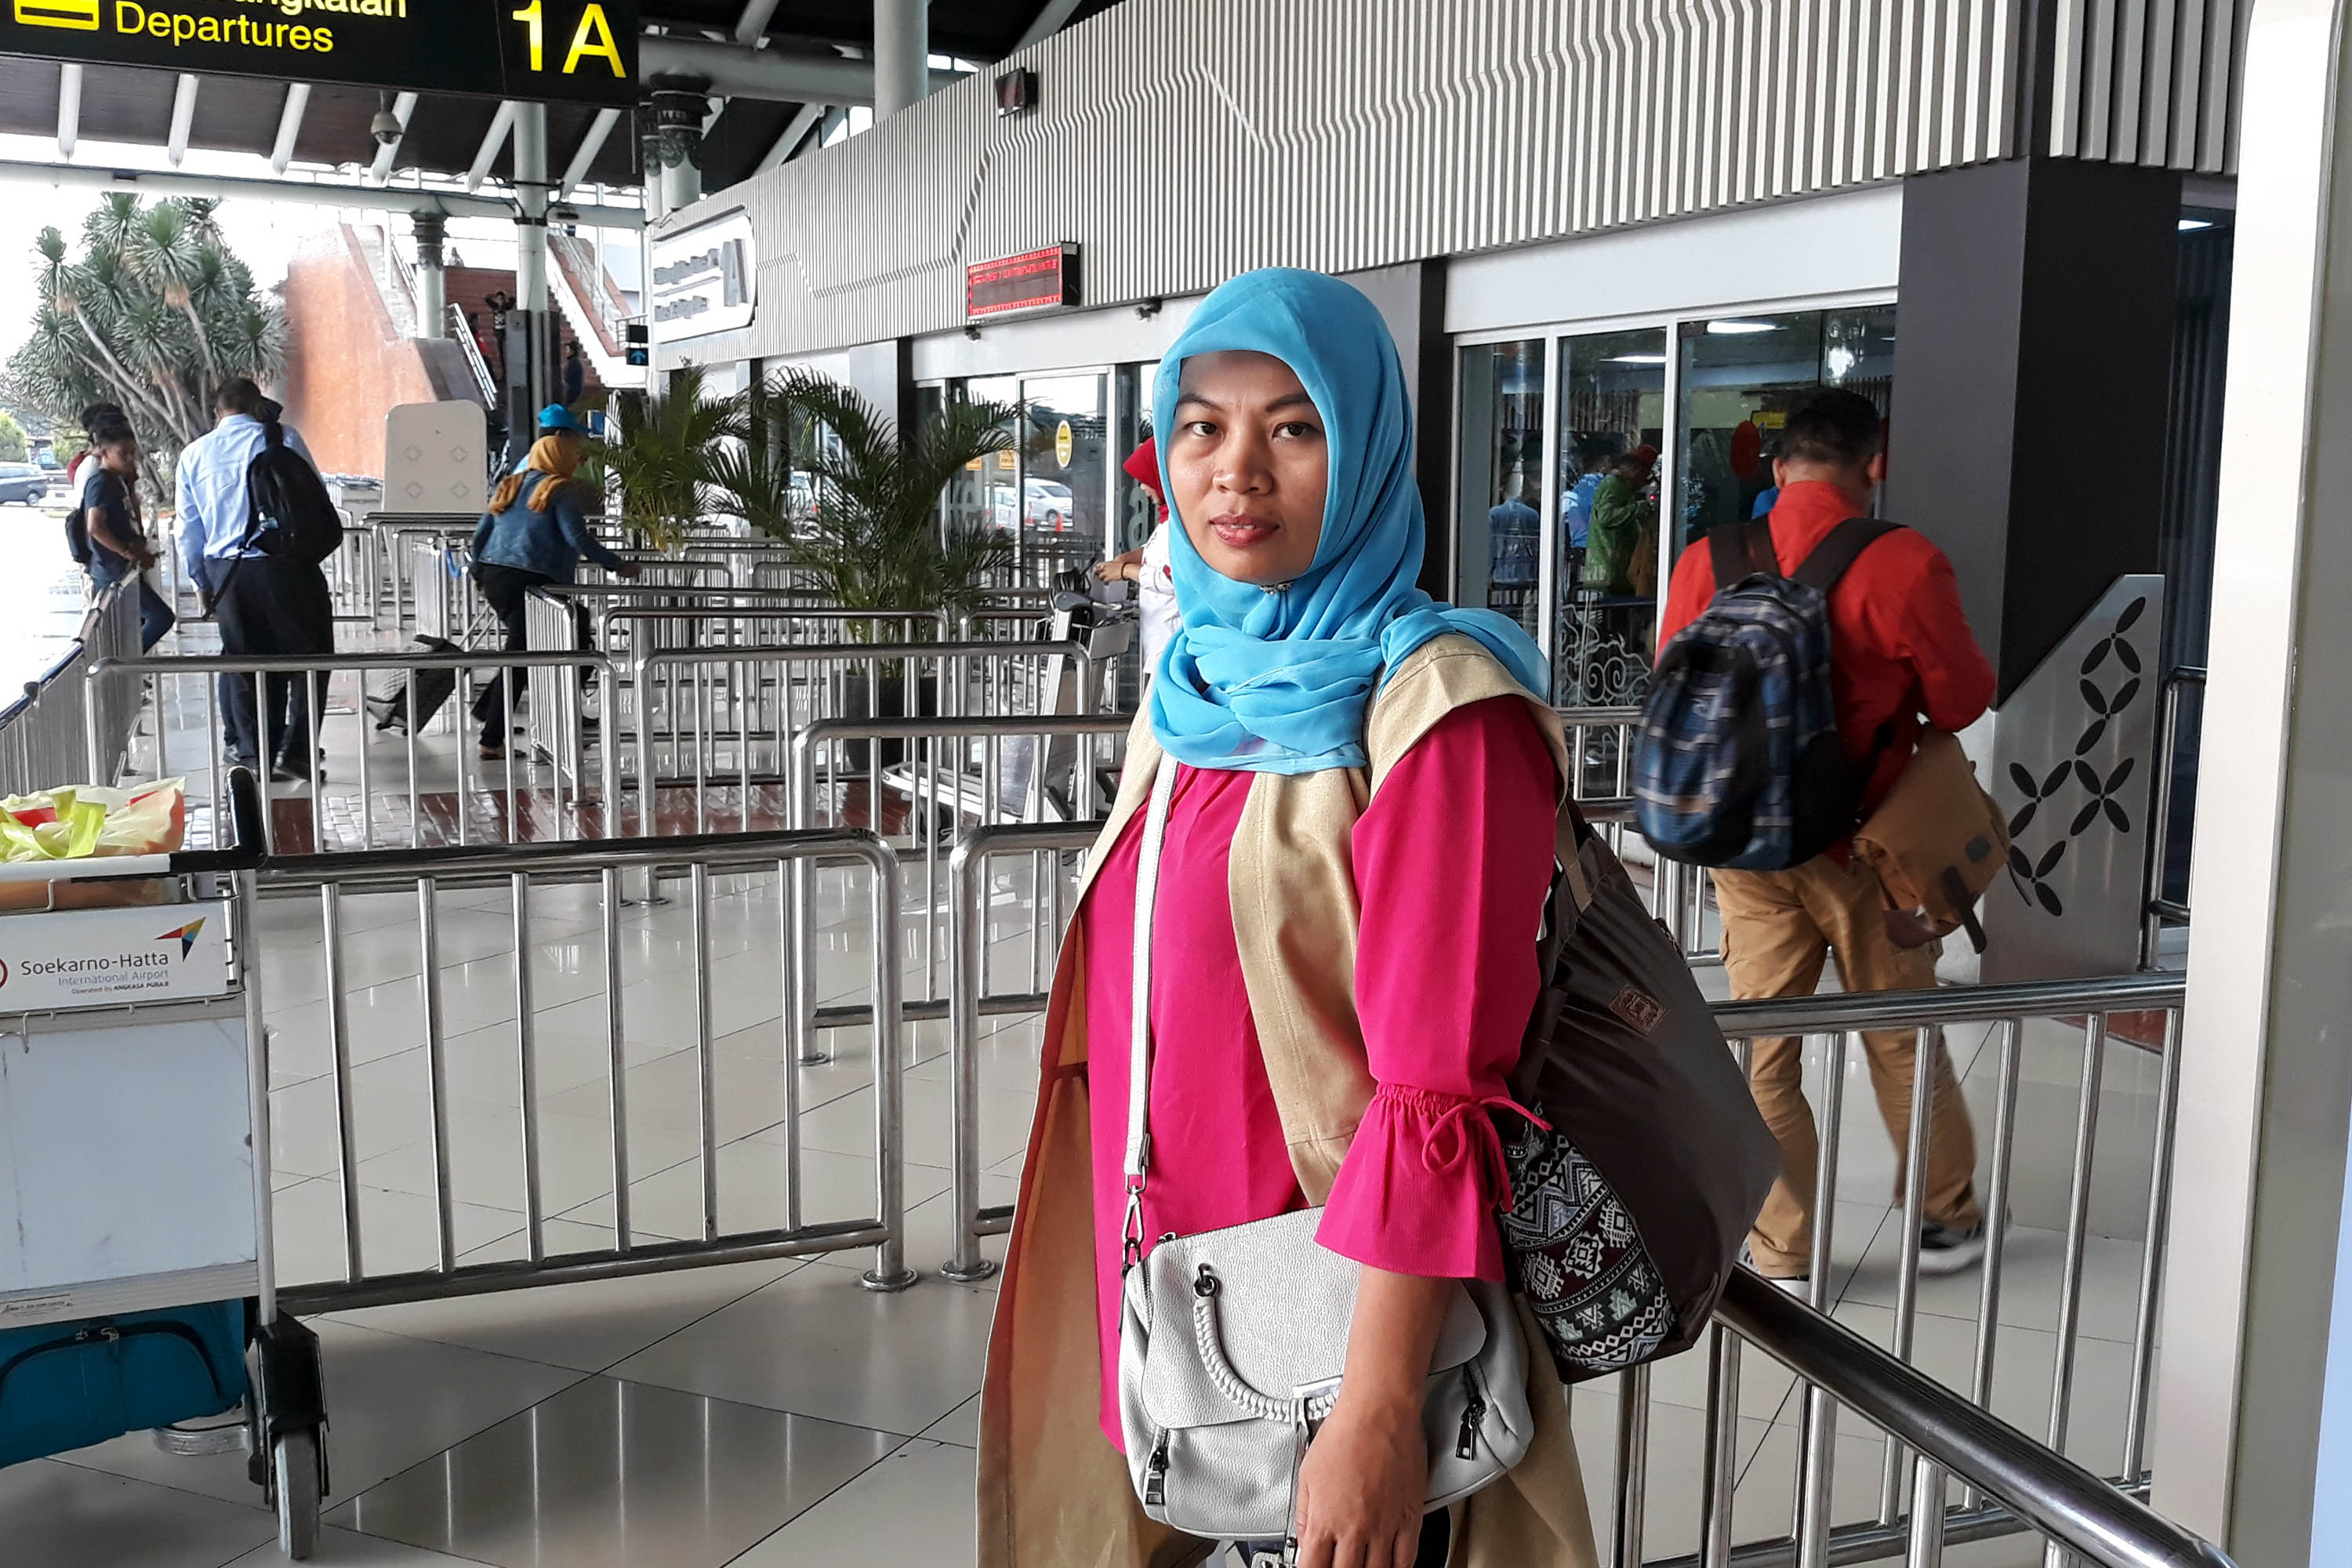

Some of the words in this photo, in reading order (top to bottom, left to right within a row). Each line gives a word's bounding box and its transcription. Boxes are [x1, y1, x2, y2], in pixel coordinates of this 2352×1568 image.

[115, 1, 335, 53] Departures
[21, 952, 169, 975] Soekarno-Hatta
[58, 971, 128, 985] International
[131, 970, 169, 981] Airport
